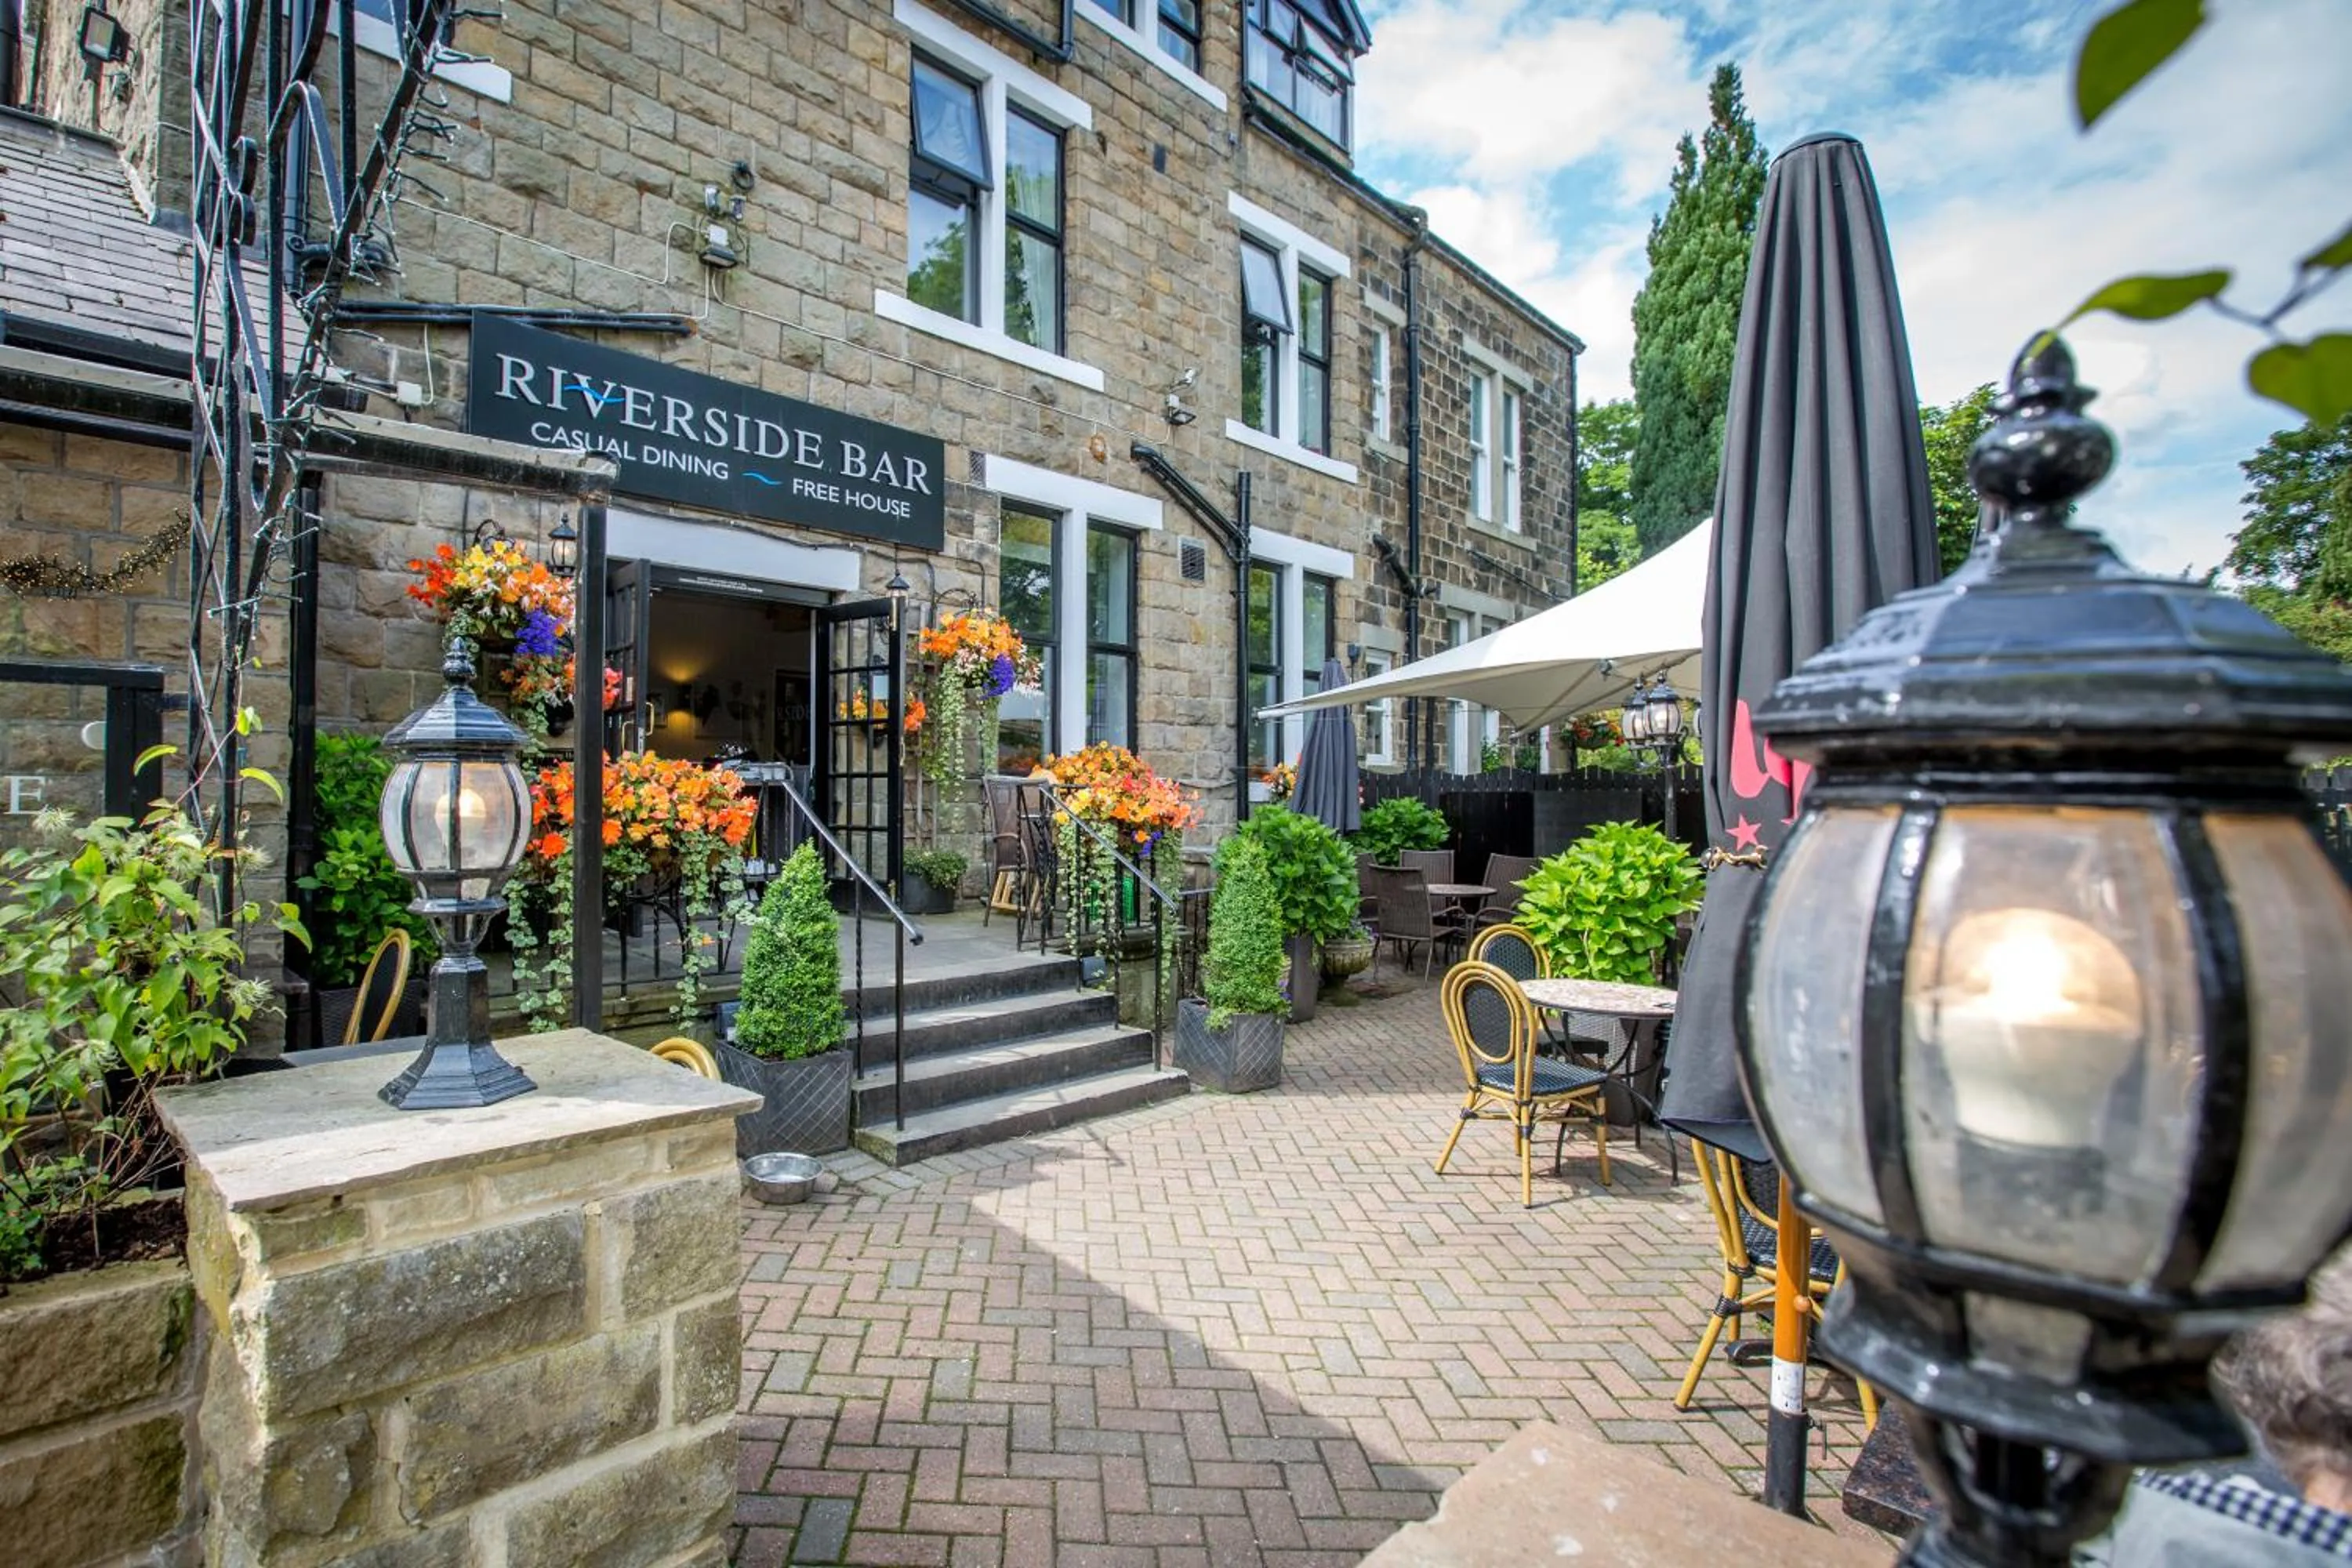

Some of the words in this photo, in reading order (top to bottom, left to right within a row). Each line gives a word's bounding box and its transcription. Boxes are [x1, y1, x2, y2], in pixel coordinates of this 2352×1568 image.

[495, 353, 824, 469] RIVERSIDE
[840, 440, 932, 495] BAR
[531, 422, 637, 461] CASUAL
[642, 445, 729, 480] DINING
[793, 477, 840, 503] FREE
[845, 489, 911, 517] HOUSE
